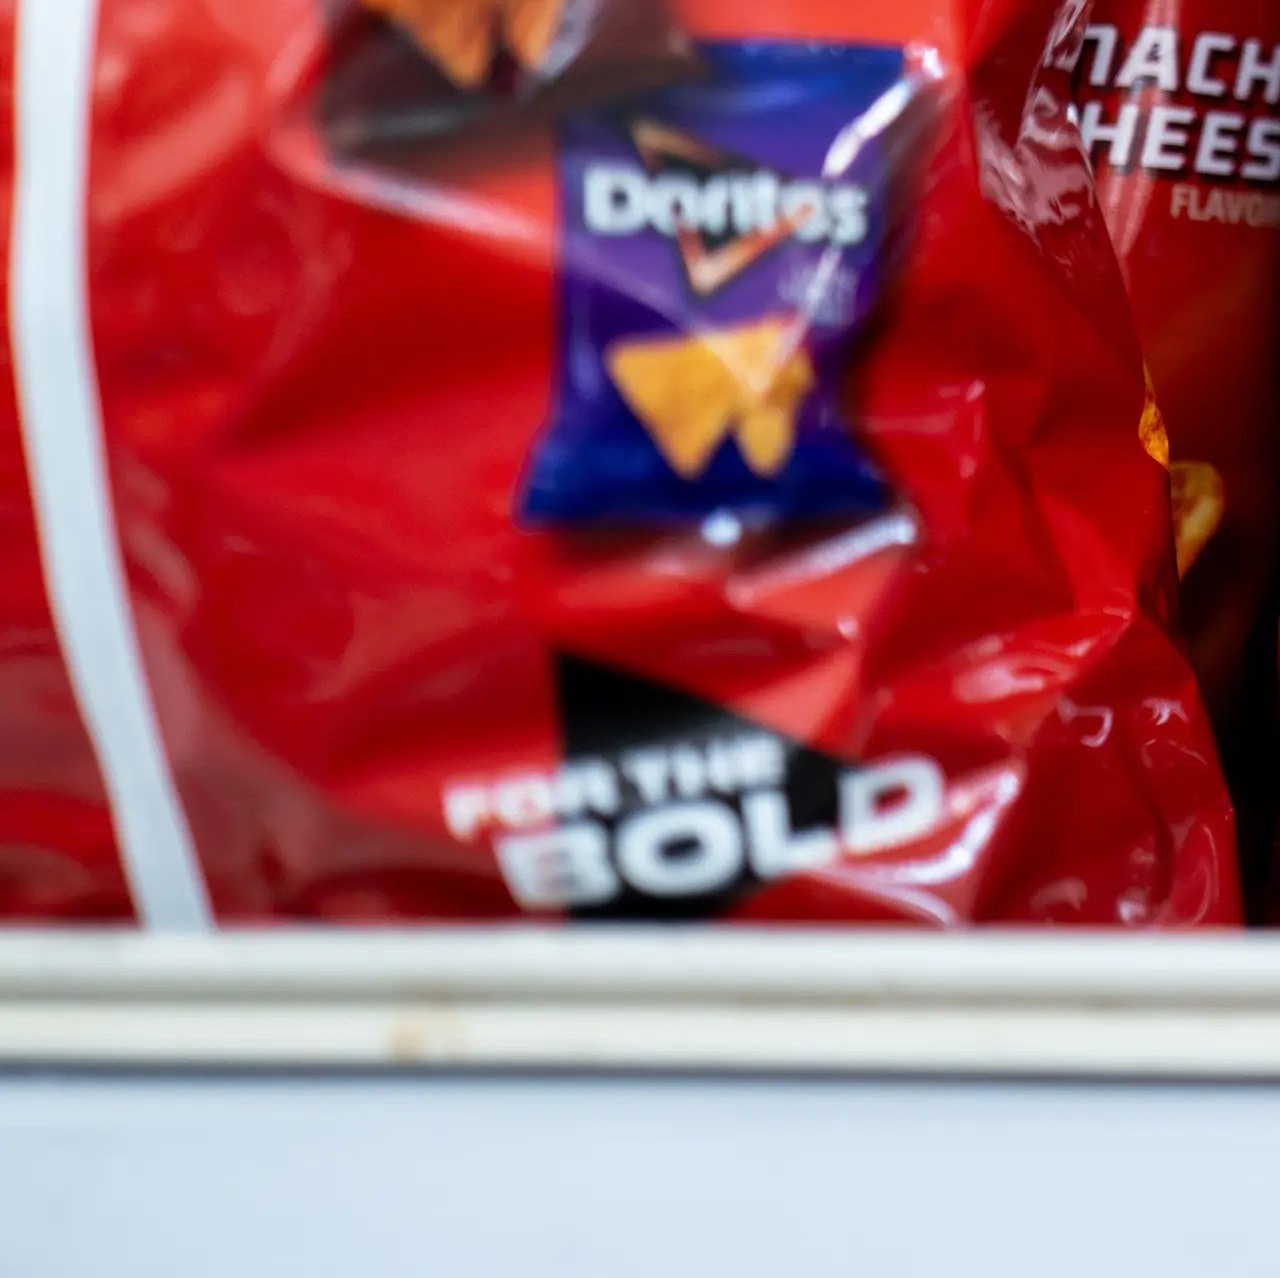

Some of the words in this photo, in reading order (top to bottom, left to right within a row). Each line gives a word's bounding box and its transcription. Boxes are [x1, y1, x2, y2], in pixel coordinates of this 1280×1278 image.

[580, 162, 872, 245] Doritos
[440, 758, 620, 841] FOR
[620, 732, 788, 808] THE
[492, 751, 948, 911] BOLD
